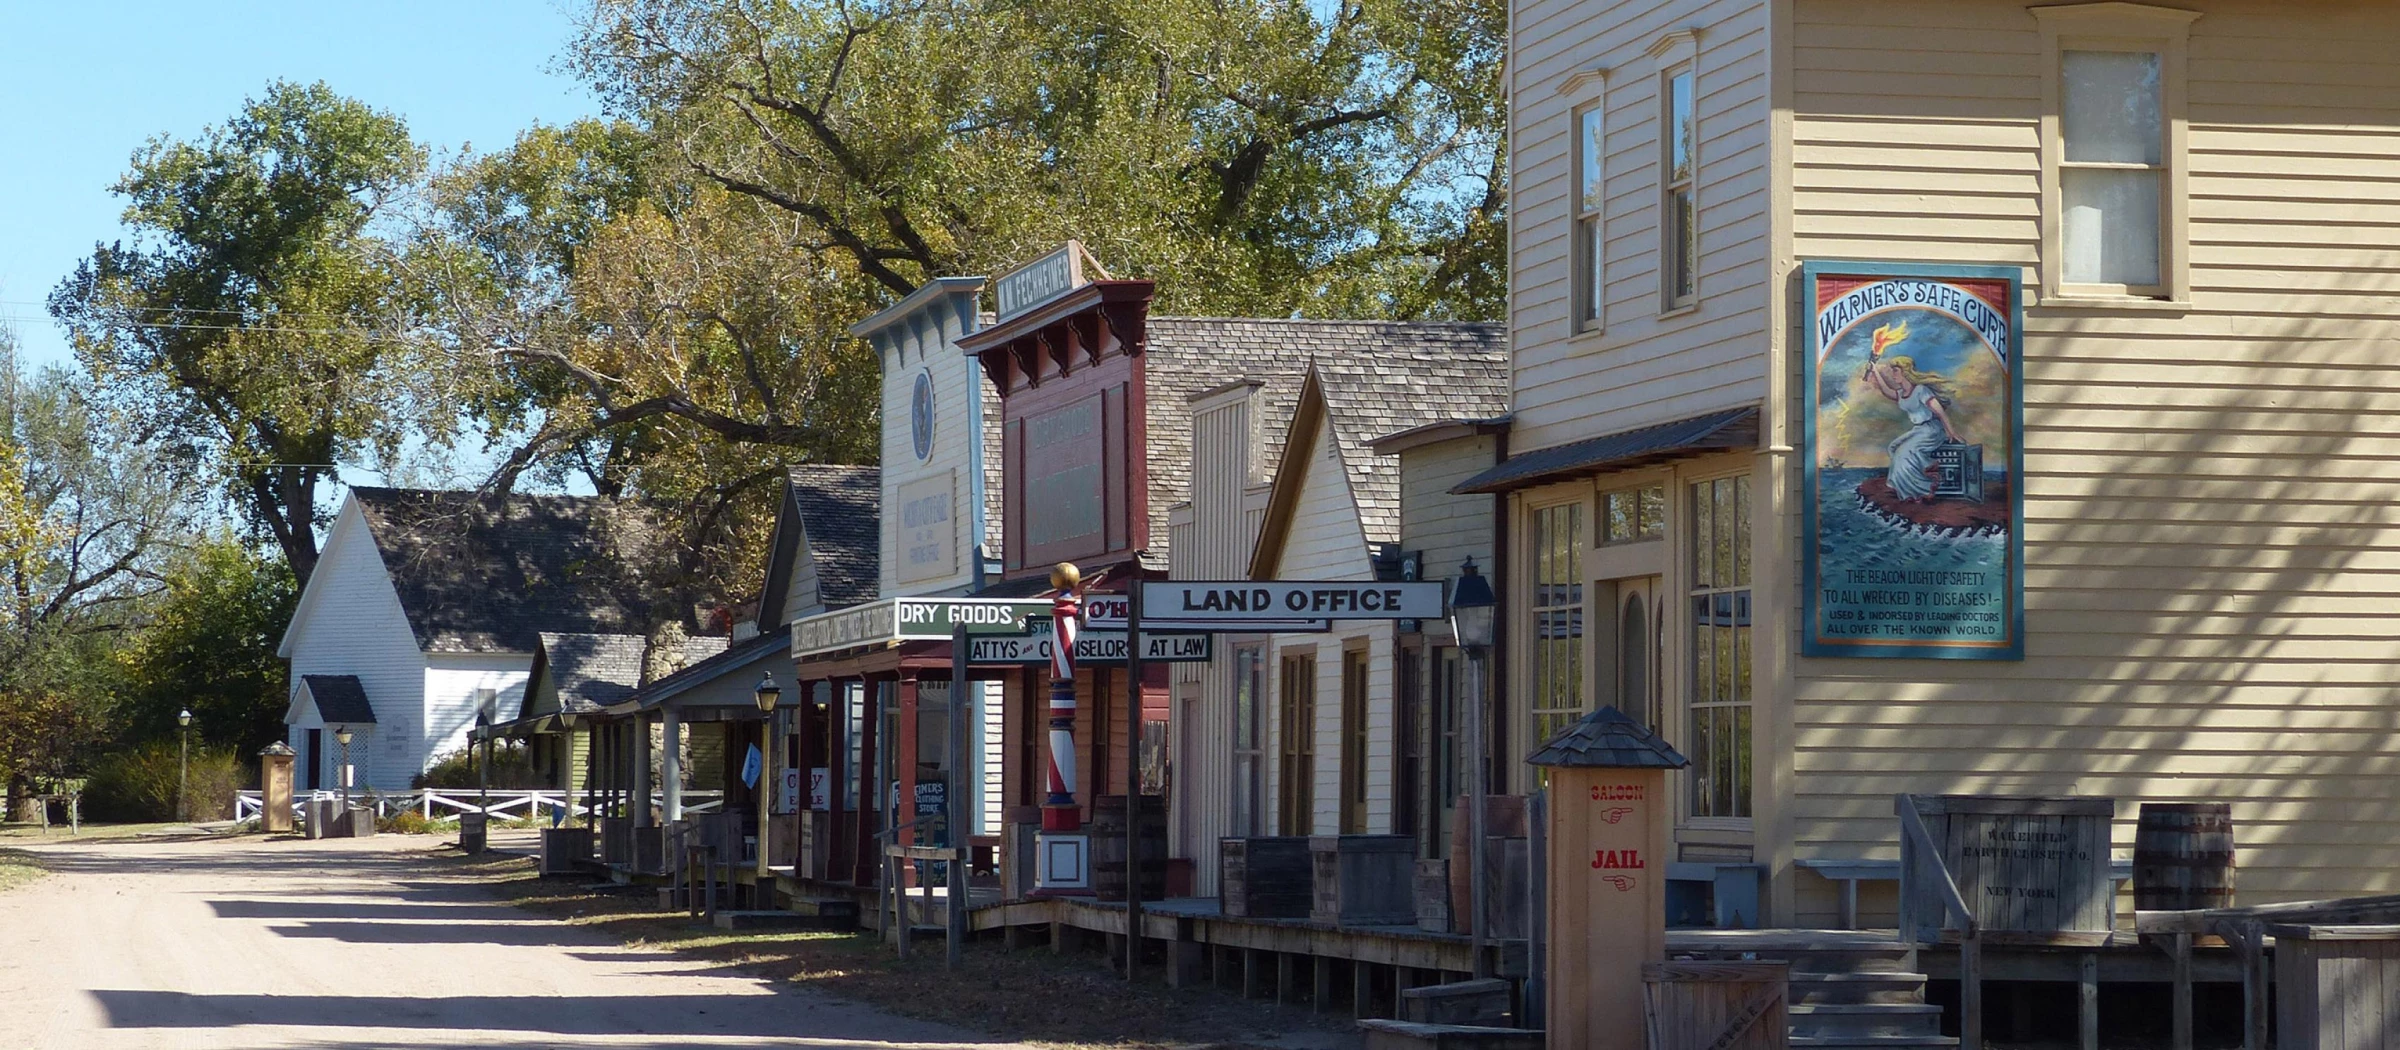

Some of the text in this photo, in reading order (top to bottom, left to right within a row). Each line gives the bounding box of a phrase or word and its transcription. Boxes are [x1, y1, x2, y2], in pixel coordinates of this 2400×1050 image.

[1819, 280, 2008, 364] WARNER'S SAFE CURE
[1845, 569, 1986, 586] THE BEACON LIGHT OF SAFETY
[1182, 588, 1403, 612] LAND OFFICE
[1823, 589, 1838, 604] TO
[1841, 590, 1858, 604] ALL
[1862, 590, 1910, 605] WRECKED
[1915, 591, 1929, 606] BY
[900, 604, 940, 624] DRY
[947, 605, 1013, 625] GOODS
[1829, 610, 2000, 622] USED & INDORSED BY LEADING DOCTORS
[1826, 624, 1846, 634] ALL
[1850, 624, 1879, 635] OVER
[1883, 624, 1904, 635] THE
[1910, 625, 1950, 635] KNOWN
[972, 640, 1019, 660] ATTYS
[1039, 639, 1129, 658] CSELOR
[1148, 638, 1168, 656] AT
[1173, 638, 1206, 656] LAW
[1591, 785, 1644, 800] SALOON
[1988, 831, 2067, 843] WAKEFIELD
[1591, 850, 1645, 869] JAIL
[1963, 847, 2010, 859] EARTH
[2013, 848, 2065, 860] CLOSET
[1986, 886, 2056, 899] NEW YORK
